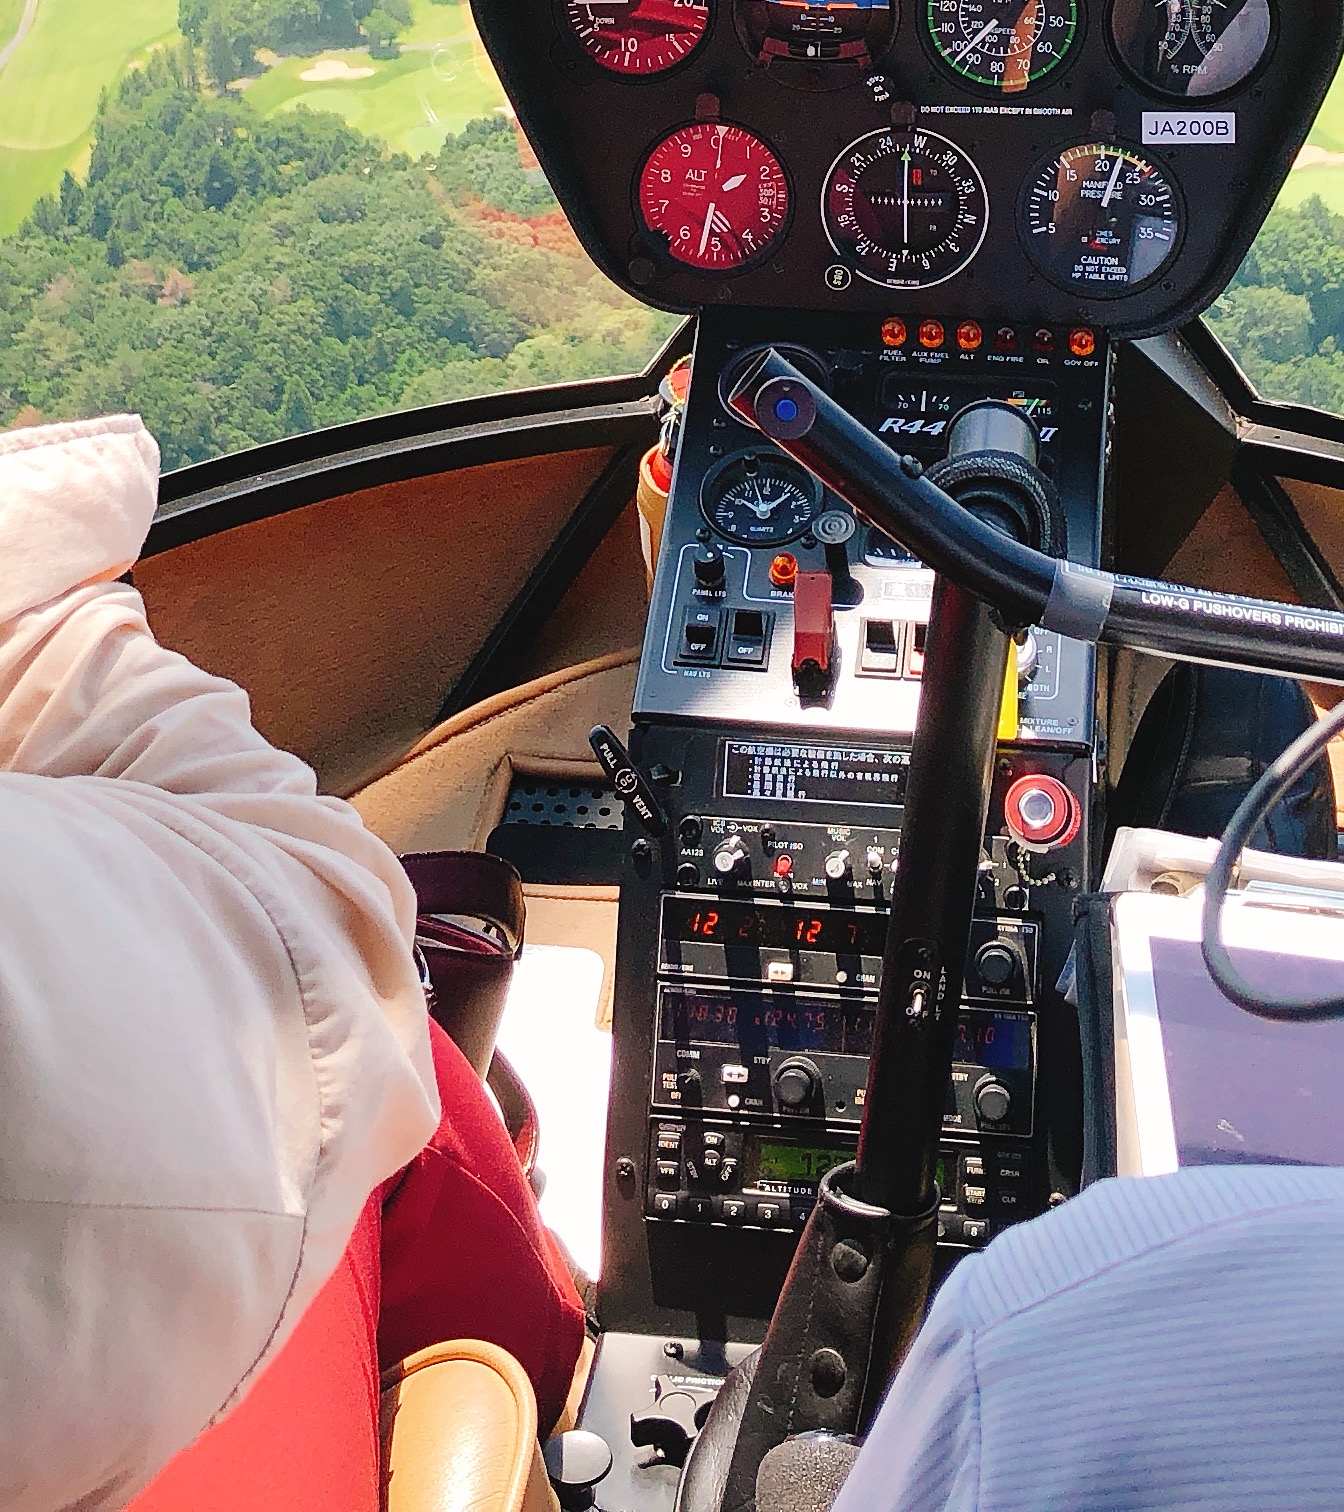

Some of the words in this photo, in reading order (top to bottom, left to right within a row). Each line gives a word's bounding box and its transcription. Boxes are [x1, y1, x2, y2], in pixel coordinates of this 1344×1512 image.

[940, 1, 957, 11] 120
[1049, 17, 1064, 27] 50
[941, 23, 955, 33] 110
[666, 34, 675, 42] 15
[1206, 34, 1215, 42] 60
[621, 38, 638, 52] 10
[952, 41, 969, 51] 100
[1037, 42, 1052, 52] 60
[966, 54, 981, 64] 90
[1017, 59, 1030, 70] 70
[990, 62, 1004, 72] 80
[1171, 65, 1179, 73] %
[1183, 65, 1208, 74] RPM
[1148, 120, 1230, 136] JA200B
[879, 136, 893, 149] 24
[914, 134, 927, 148] W
[681, 145, 691, 157] 9
[850, 152, 865, 166] 21
[943, 151, 958, 166] 30
[1095, 161, 1109, 171] 20
[661, 169, 671, 182] 8
[685, 169, 707, 181] ALT
[760, 166, 770, 180] 2
[1066, 171, 1077, 181] 15
[1126, 173, 1141, 184] 25
[836, 184, 849, 193] S
[962, 178, 975, 194] 33
[1048, 191, 1059, 201] 10
[1139, 195, 1155, 206] 30
[659, 200, 669, 213] 7
[760, 208, 770, 222] 3
[963, 214, 977, 224] N
[838, 214, 850, 228] 15
[680, 226, 690, 239] 6
[1048, 223, 1056, 234] 5
[1139, 227, 1154, 239] 35
[742, 229, 753, 241] 4
[711, 238, 721, 251] 5
[856, 242, 870, 256] 12
[949, 242, 960, 253] 3
[888, 259, 898, 271] E
[922, 259, 930, 270] 6
[1081, 256, 1118, 265] CAUTION
[833, 270, 843, 285] OBS
[912, 350, 928, 358] AUX
[879, 417, 946, 435] R44
[1141, 591, 1190, 611] LOW-G
[1193, 600, 1281, 626] PUSHOVERS
[1027, 684, 1050, 692] BOTH
[1020, 717, 1058, 726] MIXTURE
[600, 743, 617, 768] PULL
[633, 795, 652, 819] VENT
[831, 834, 846, 842] VOL
[867, 846, 884, 854] COM
[856, 973, 875, 983] CHAN
[914, 969, 931, 979] ON
[937, 966, 946, 1000] LAND
[935, 1005, 941, 1020] LT
[677, 1050, 700, 1059] COMM
[764, 1184, 812, 1195] ALTITUDE
[661, 1199, 669, 1209] 0
[698, 1204, 701, 1212] 1
[731, 1206, 737, 1216] 2
[765, 1209, 771, 1219] 3
[799, 1212, 805, 1220] 4
[971, 1227, 977, 1236] 8
